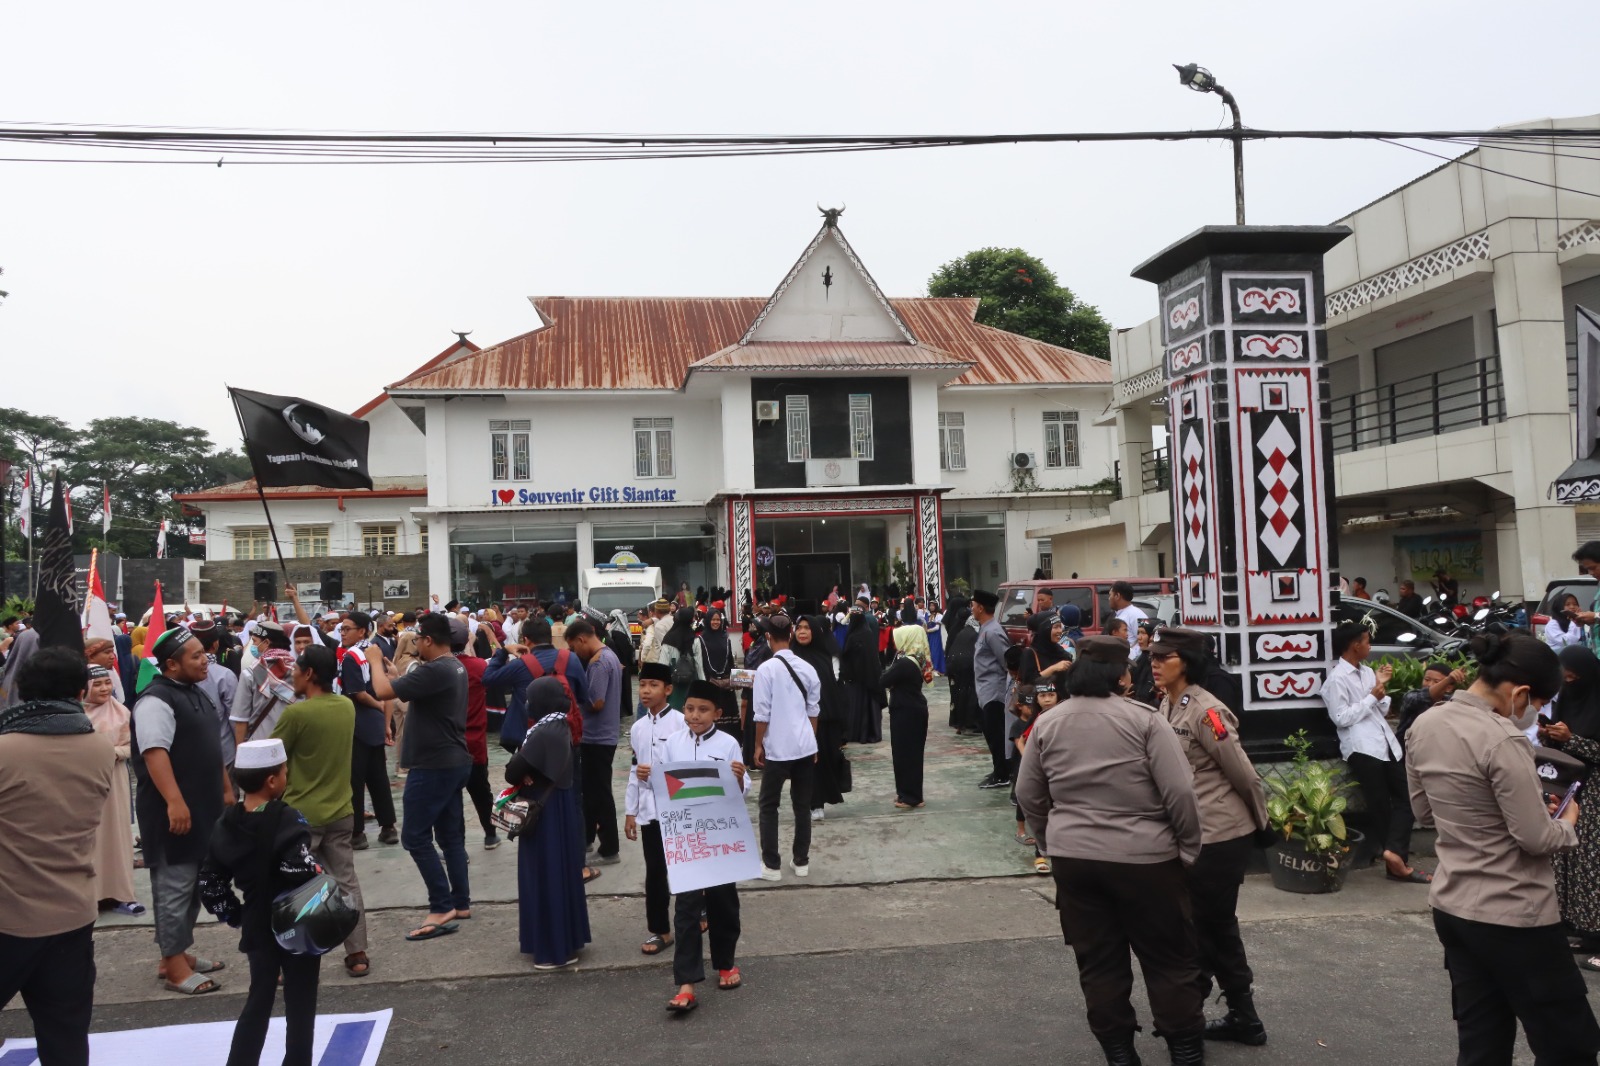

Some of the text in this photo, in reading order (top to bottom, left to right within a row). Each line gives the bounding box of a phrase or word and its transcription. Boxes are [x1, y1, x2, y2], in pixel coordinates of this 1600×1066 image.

[491, 486, 677, 505] I Souvenir Gift Siantar
[660, 808, 693, 821] SAVE
[664, 832, 708, 851] FREE
[665, 840, 747, 866] PALESTINE
